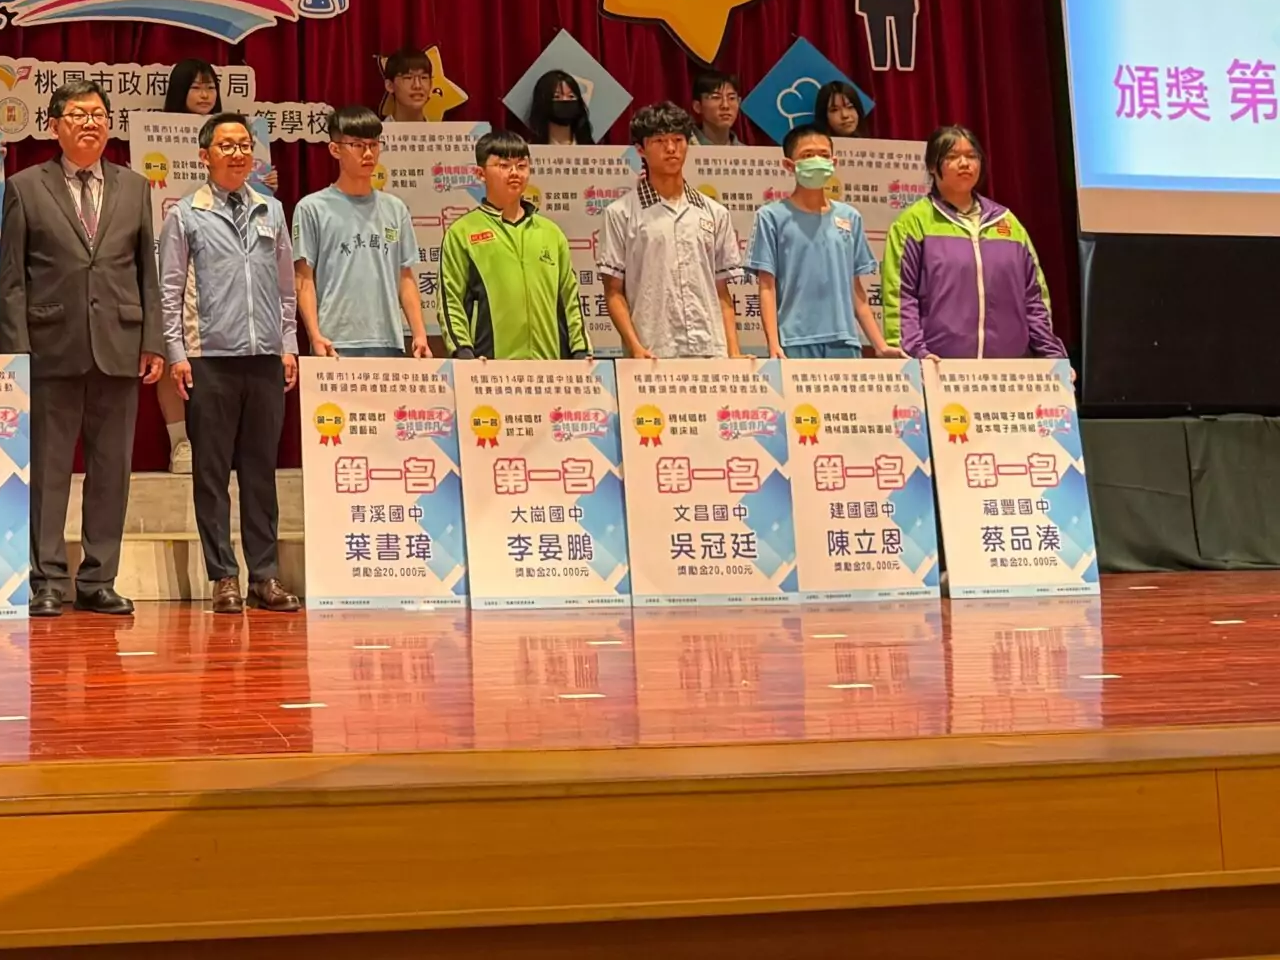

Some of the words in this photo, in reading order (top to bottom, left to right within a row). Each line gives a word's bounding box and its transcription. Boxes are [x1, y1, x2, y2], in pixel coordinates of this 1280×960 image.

[1114, 63, 1211, 122] 頒獎
[1226, 58, 1280, 124] 第
[316, 372, 448, 382] 桃園市114學年度國中技藝教育
[320, 383, 446, 393] 競賽頒獎典禮暨成果發表活動
[335, 456, 436, 494] 第一名
[493, 457, 595, 495] 第一名
[656, 456, 760, 494] 第一名
[814, 454, 905, 491] 第一名
[964, 452, 1060, 488] 第一名
[351, 505, 424, 523] 青溪國中
[511, 505, 583, 523] 大崗國中
[674, 504, 748, 522] 文昌國中
[829, 501, 895, 519] 建國國中
[982, 498, 1050, 516] 福豐國中
[345, 532, 432, 562] 葉書瑋
[507, 533, 593, 561] 李晏鵬
[670, 531, 757, 560] 吳冠廷
[827, 528, 904, 557] 陳立恩
[980, 524, 1061, 553] 蔡品溱
[352, 566, 427, 578] 獎勵金20,000元
[515, 566, 589, 578] 獎勵金20,000元
[677, 565, 753, 576] 獎勵金20,000元
